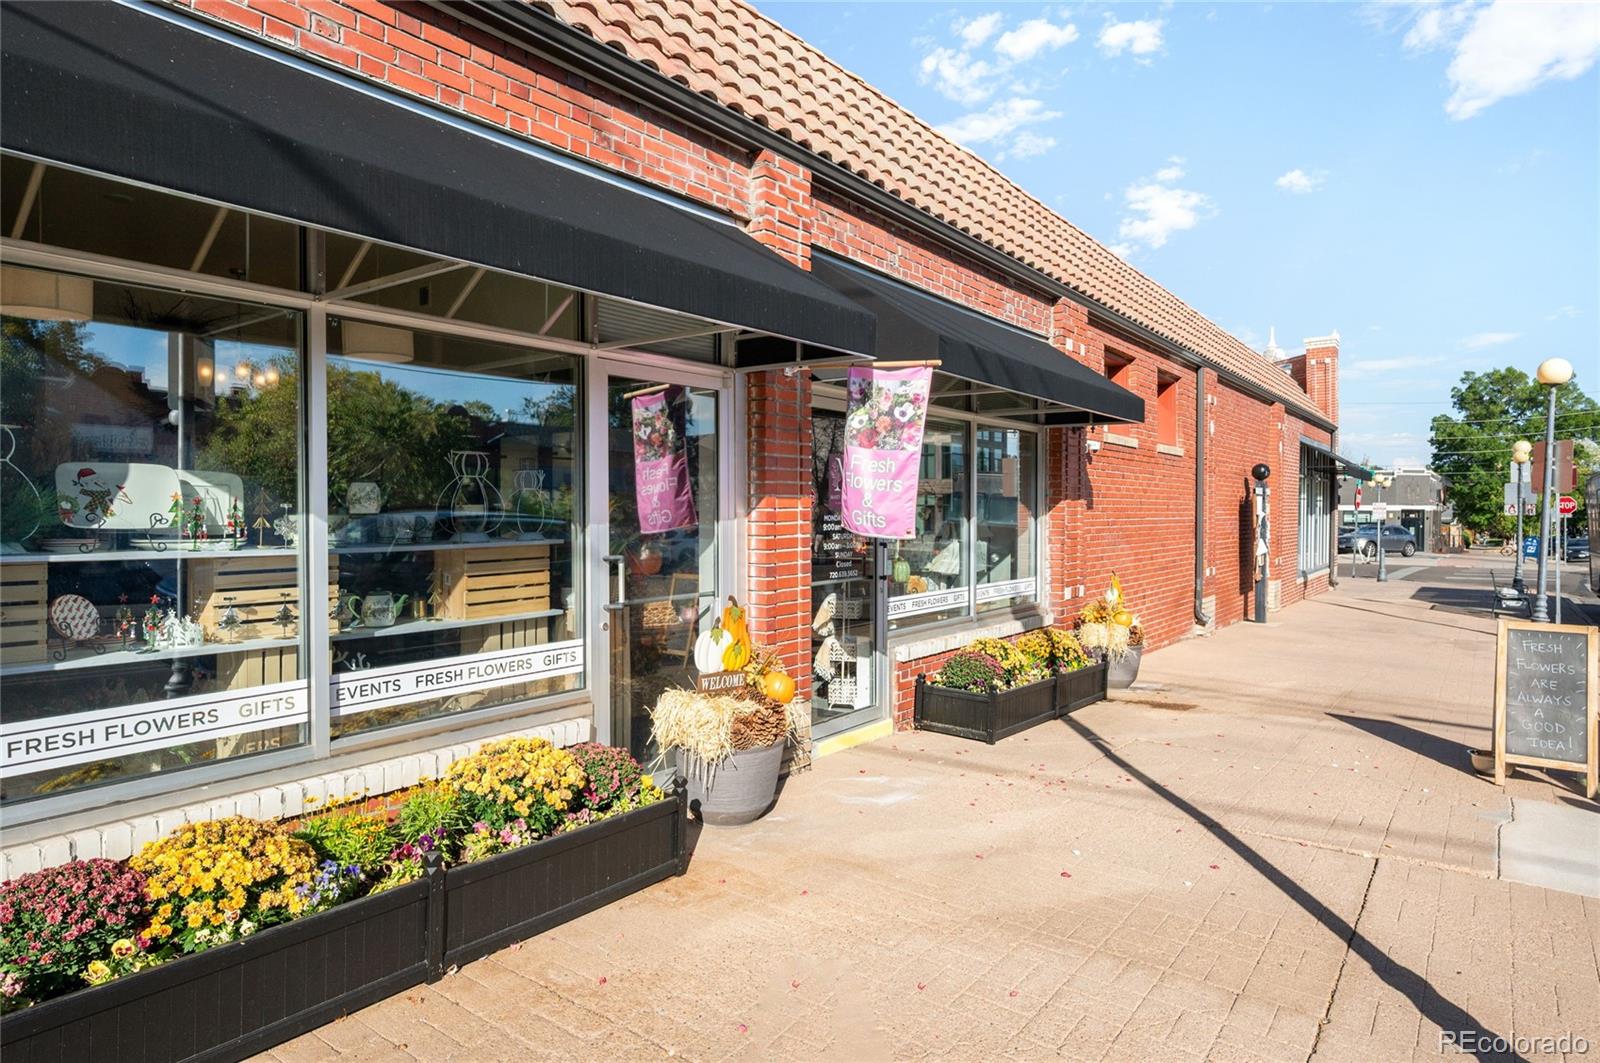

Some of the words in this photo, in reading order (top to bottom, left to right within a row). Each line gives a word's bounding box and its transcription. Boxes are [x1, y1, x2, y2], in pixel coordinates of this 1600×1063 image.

[850, 454, 896, 474] Fresh
[844, 471, 904, 493] Flowers
[862, 492, 874, 508] &
[1559, 501, 1576, 510] TOP
[823, 514, 842, 522] MONDA
[851, 510, 888, 529] Gifts
[835, 560, 852, 568] Closed
[888, 601, 906, 614] EVENTS
[911, 598, 928, 609] FRESH
[928, 595, 949, 606] FLOWERS
[1522, 639, 1563, 654] FRESH
[1516, 657, 1576, 676] FLOWERS
[336, 678, 402, 702] EVENTS
[415, 668, 463, 688] FRESH
[468, 658, 533, 680] FLOWERS
[543, 651, 577, 667] GIFTS
[701, 673, 745, 691] WELCOME
[1530, 678, 1558, 690] ARE
[1517, 691, 1572, 706] ALWAYS
[1534, 707, 1544, 719] A
[7, 727, 95, 759] FRESH
[104, 708, 220, 742] FLOWERS
[238, 695, 296, 718] GIFTS
[1521, 719, 1567, 734] GOOD
[1526, 736, 1573, 753] IDEA!
